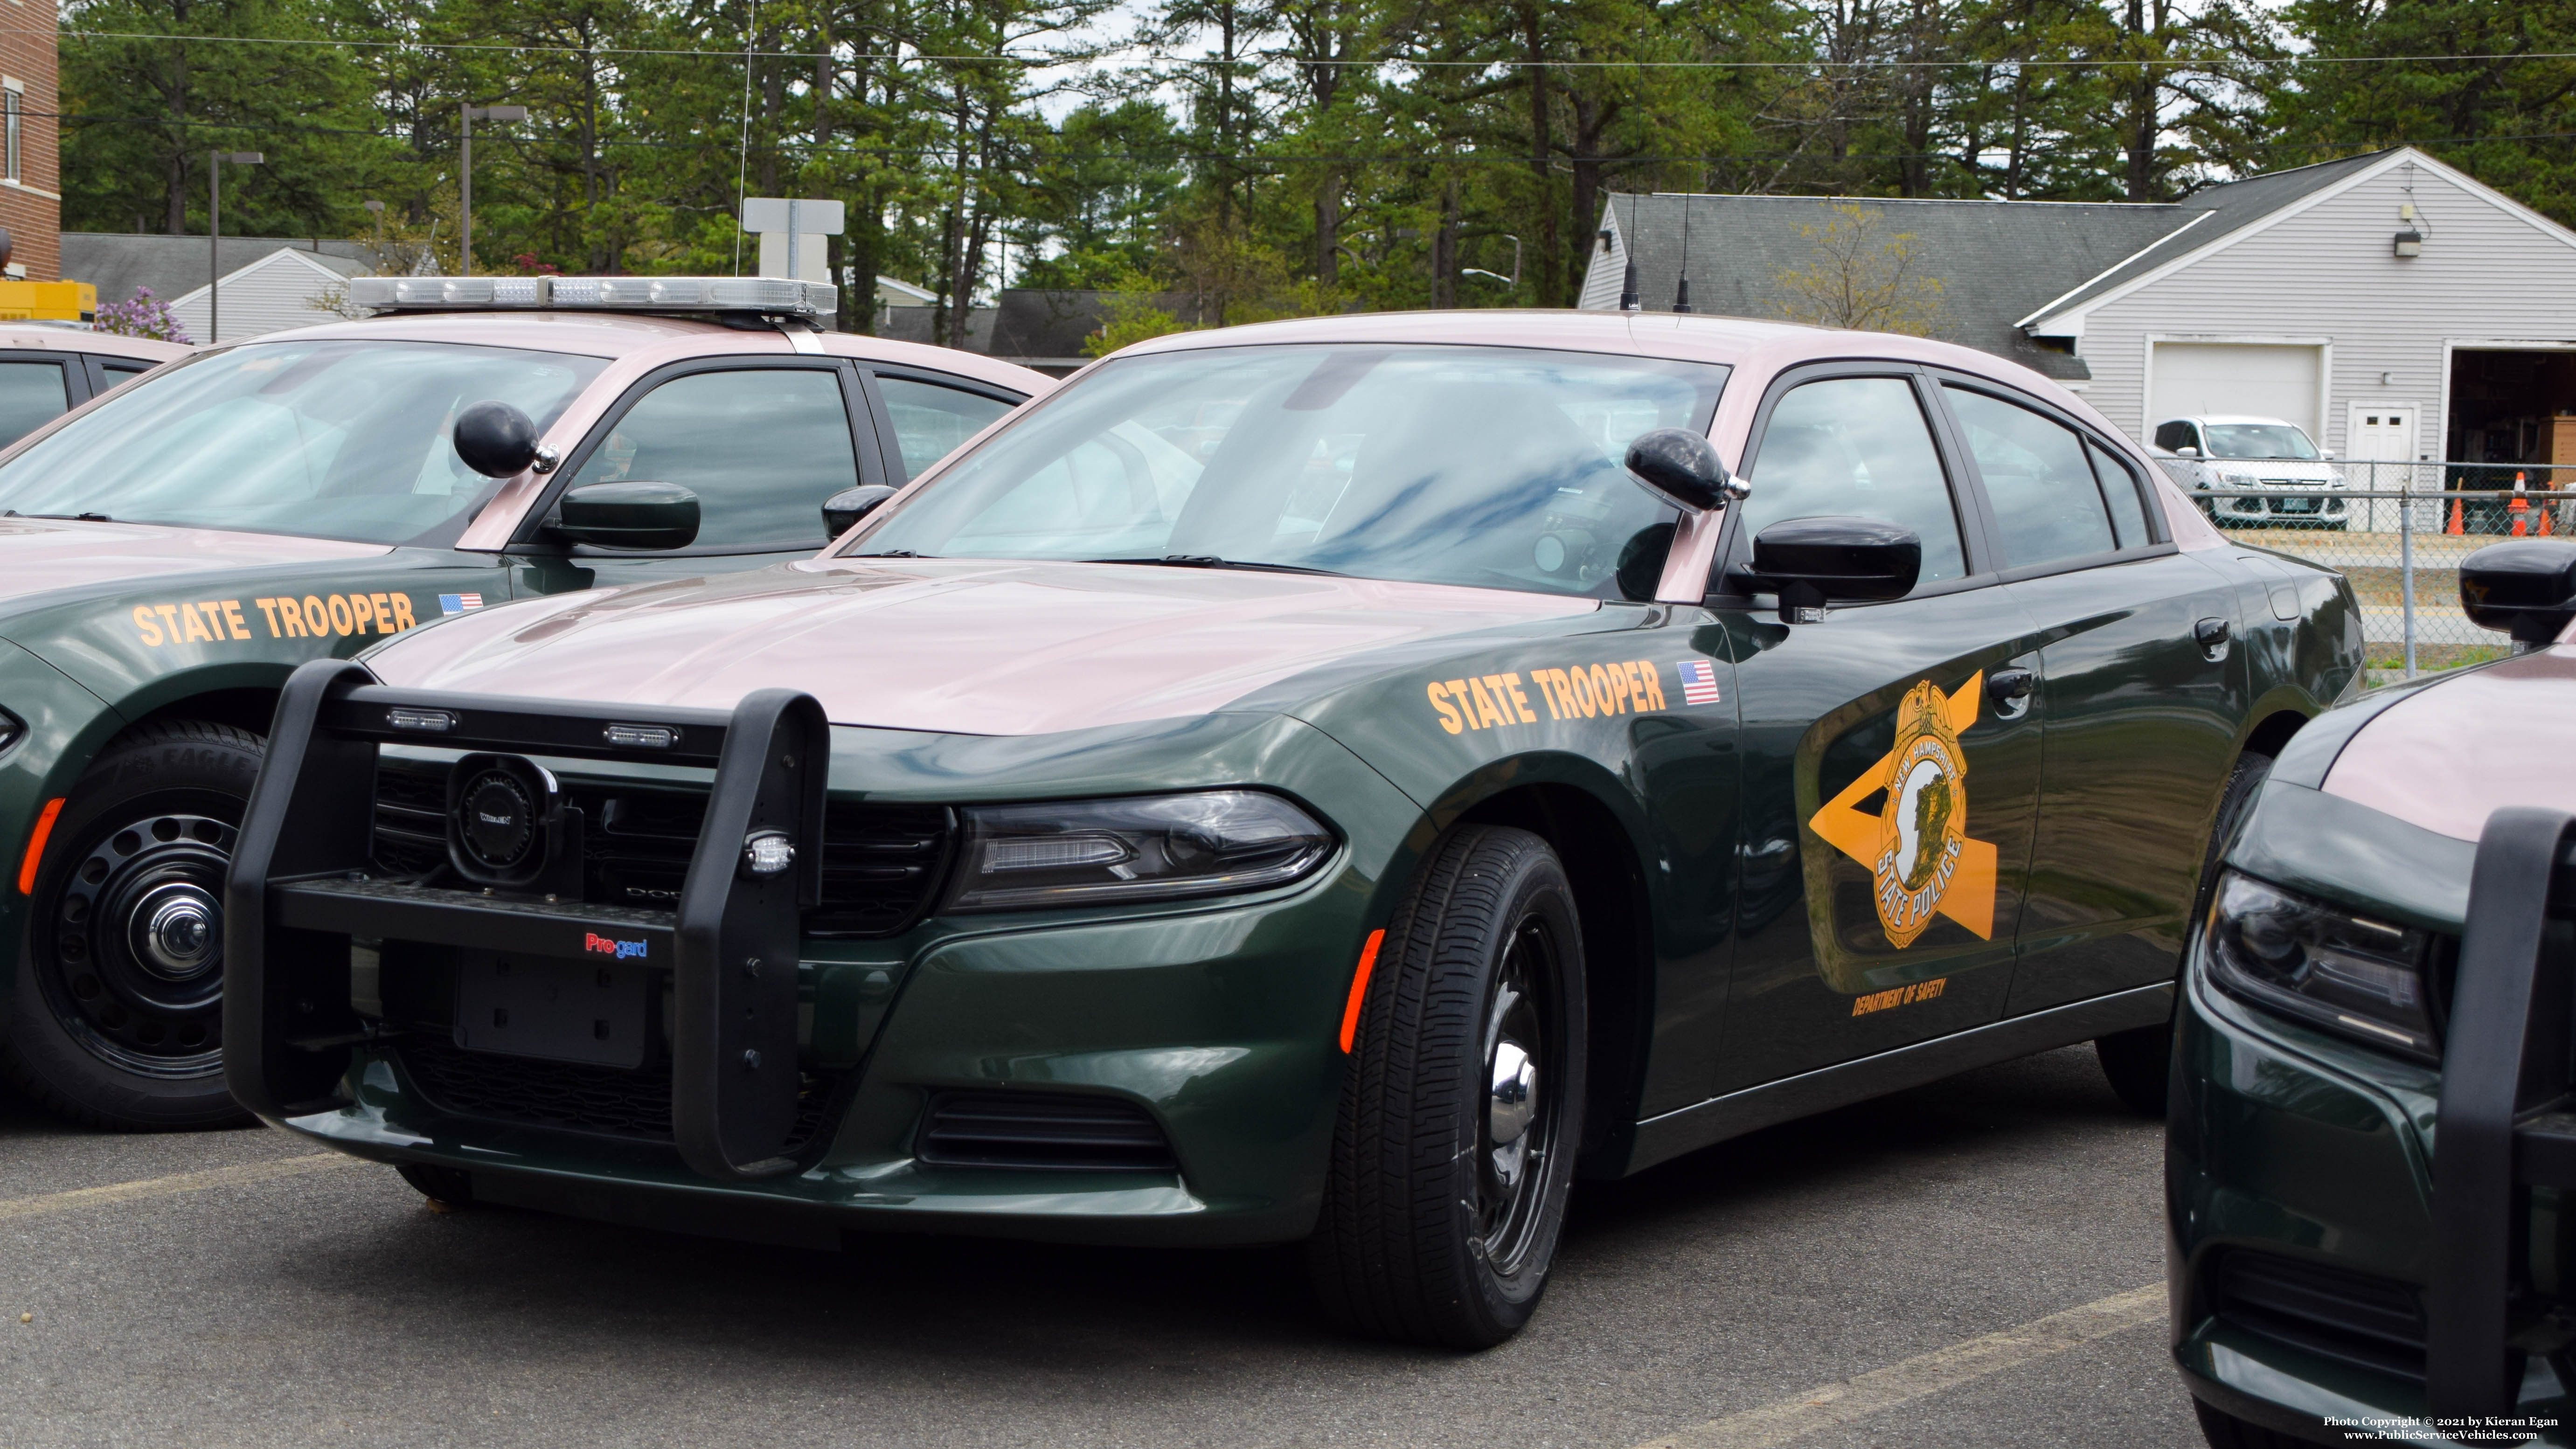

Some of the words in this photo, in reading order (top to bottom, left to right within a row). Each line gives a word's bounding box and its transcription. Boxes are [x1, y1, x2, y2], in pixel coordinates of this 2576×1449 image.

[132, 601, 251, 647] STATE
[256, 593, 416, 638] TROOPER
[1427, 672, 1537, 734] STATE
[1530, 660, 1666, 720] TROOPER
[162, 748, 251, 776] EAGLE
[1895, 756, 1911, 792] NEW
[1913, 741, 1956, 785] HAMPSHIRE
[480, 812, 511, 825] WHELEN
[1877, 849, 1909, 927] STATE
[1910, 836, 1962, 926] POLICE
[586, 933, 647, 958] Pro-gard
[1852, 987, 1904, 1017] DEPARTMENT
[1903, 984, 1916, 1004] OF
[1916, 978, 1946, 1001] SAFETY
